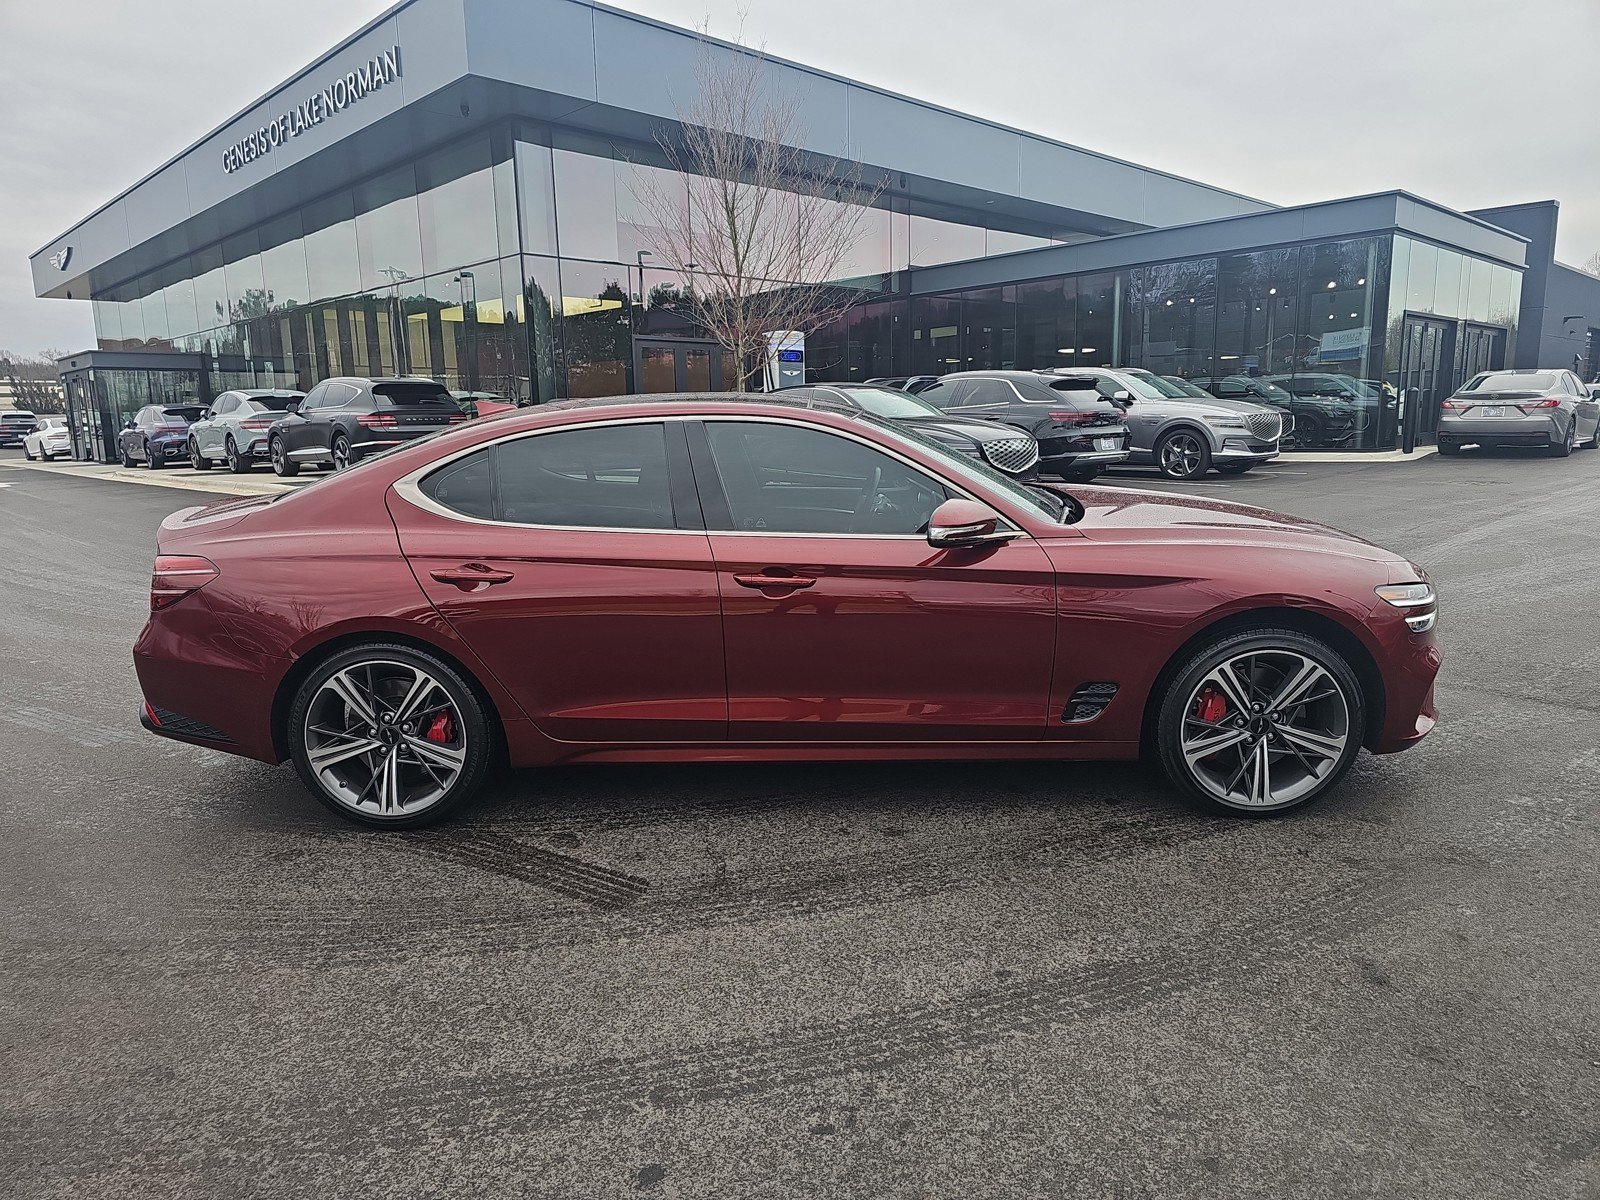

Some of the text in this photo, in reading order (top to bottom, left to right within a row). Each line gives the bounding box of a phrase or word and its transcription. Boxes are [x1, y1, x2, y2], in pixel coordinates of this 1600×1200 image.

[222, 45, 401, 174] GENESIS OF LAKE NORMAN
